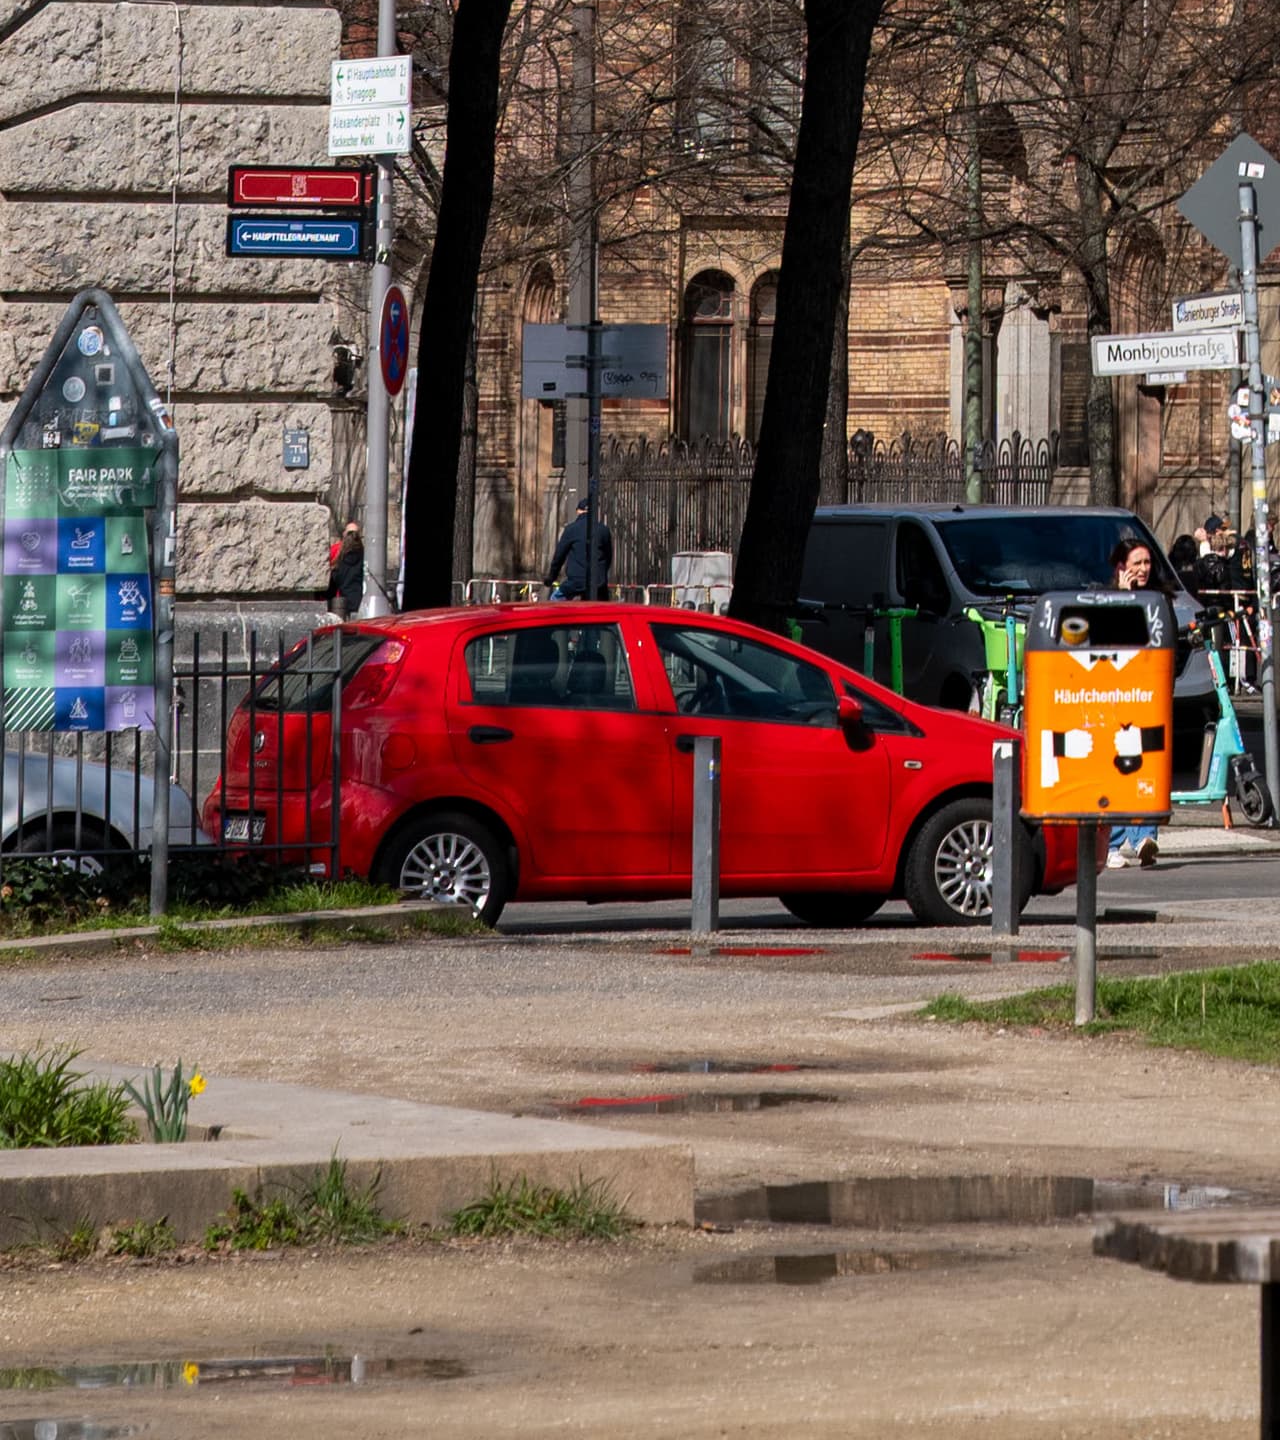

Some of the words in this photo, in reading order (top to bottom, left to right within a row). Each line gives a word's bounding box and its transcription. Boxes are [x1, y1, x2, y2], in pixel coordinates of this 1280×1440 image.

[347, 87, 376, 102] Synagoge
[333, 114, 380, 129] Alexanderplatz
[252, 232, 340, 243] HAUPTTELEGRAPHENAMT
[1220, 299, 1240, 320] Straße
[1107, 337, 1226, 364] Monbijoustraße
[68, 468, 97, 483] FAIR
[99, 467, 133, 482] PARK
[1054, 687, 1154, 704] Häufchenhelfer
